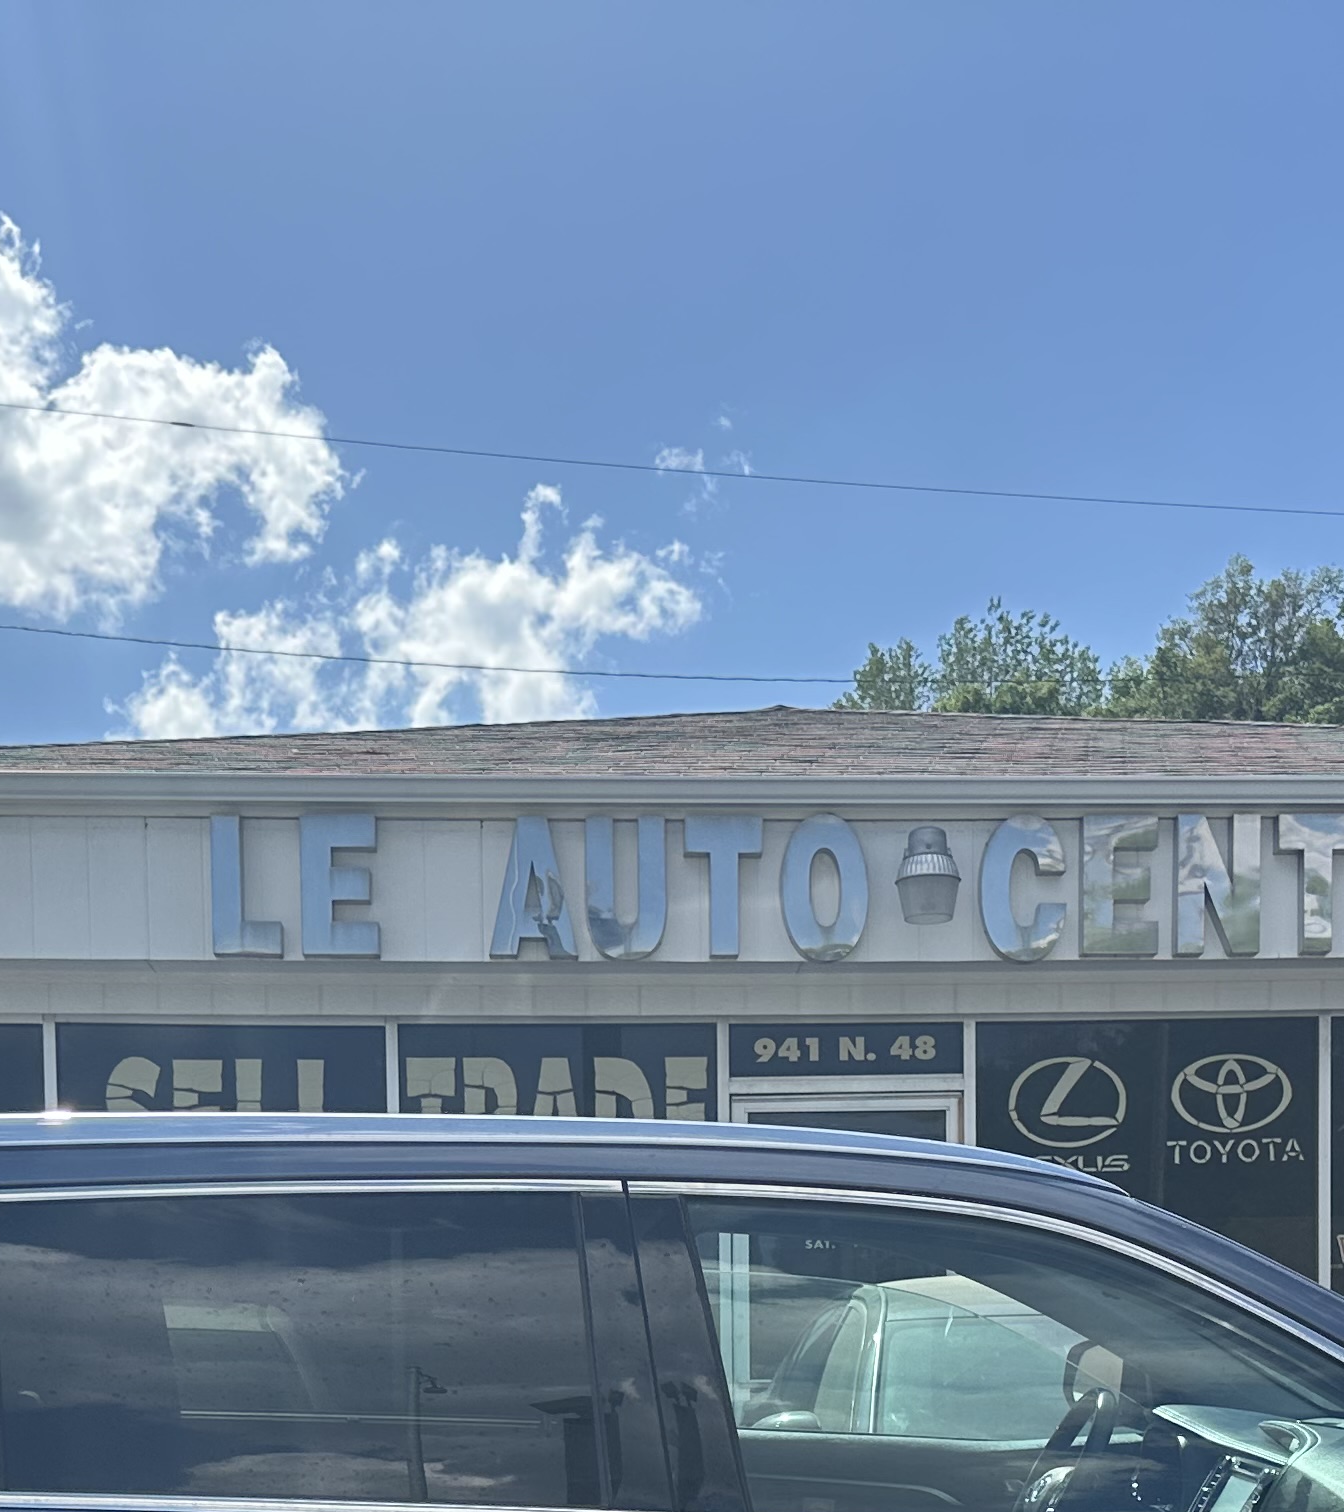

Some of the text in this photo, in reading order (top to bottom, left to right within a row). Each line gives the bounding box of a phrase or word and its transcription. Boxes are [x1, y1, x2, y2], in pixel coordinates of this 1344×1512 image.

[210, 813, 380, 959] LE
[489, 813, 869, 963] AUTO
[753, 1035, 937, 1062] 941 N. 48
[1035, 1154, 1131, 1172] XUS
[1166, 1138, 1304, 1165] TOYOTA
